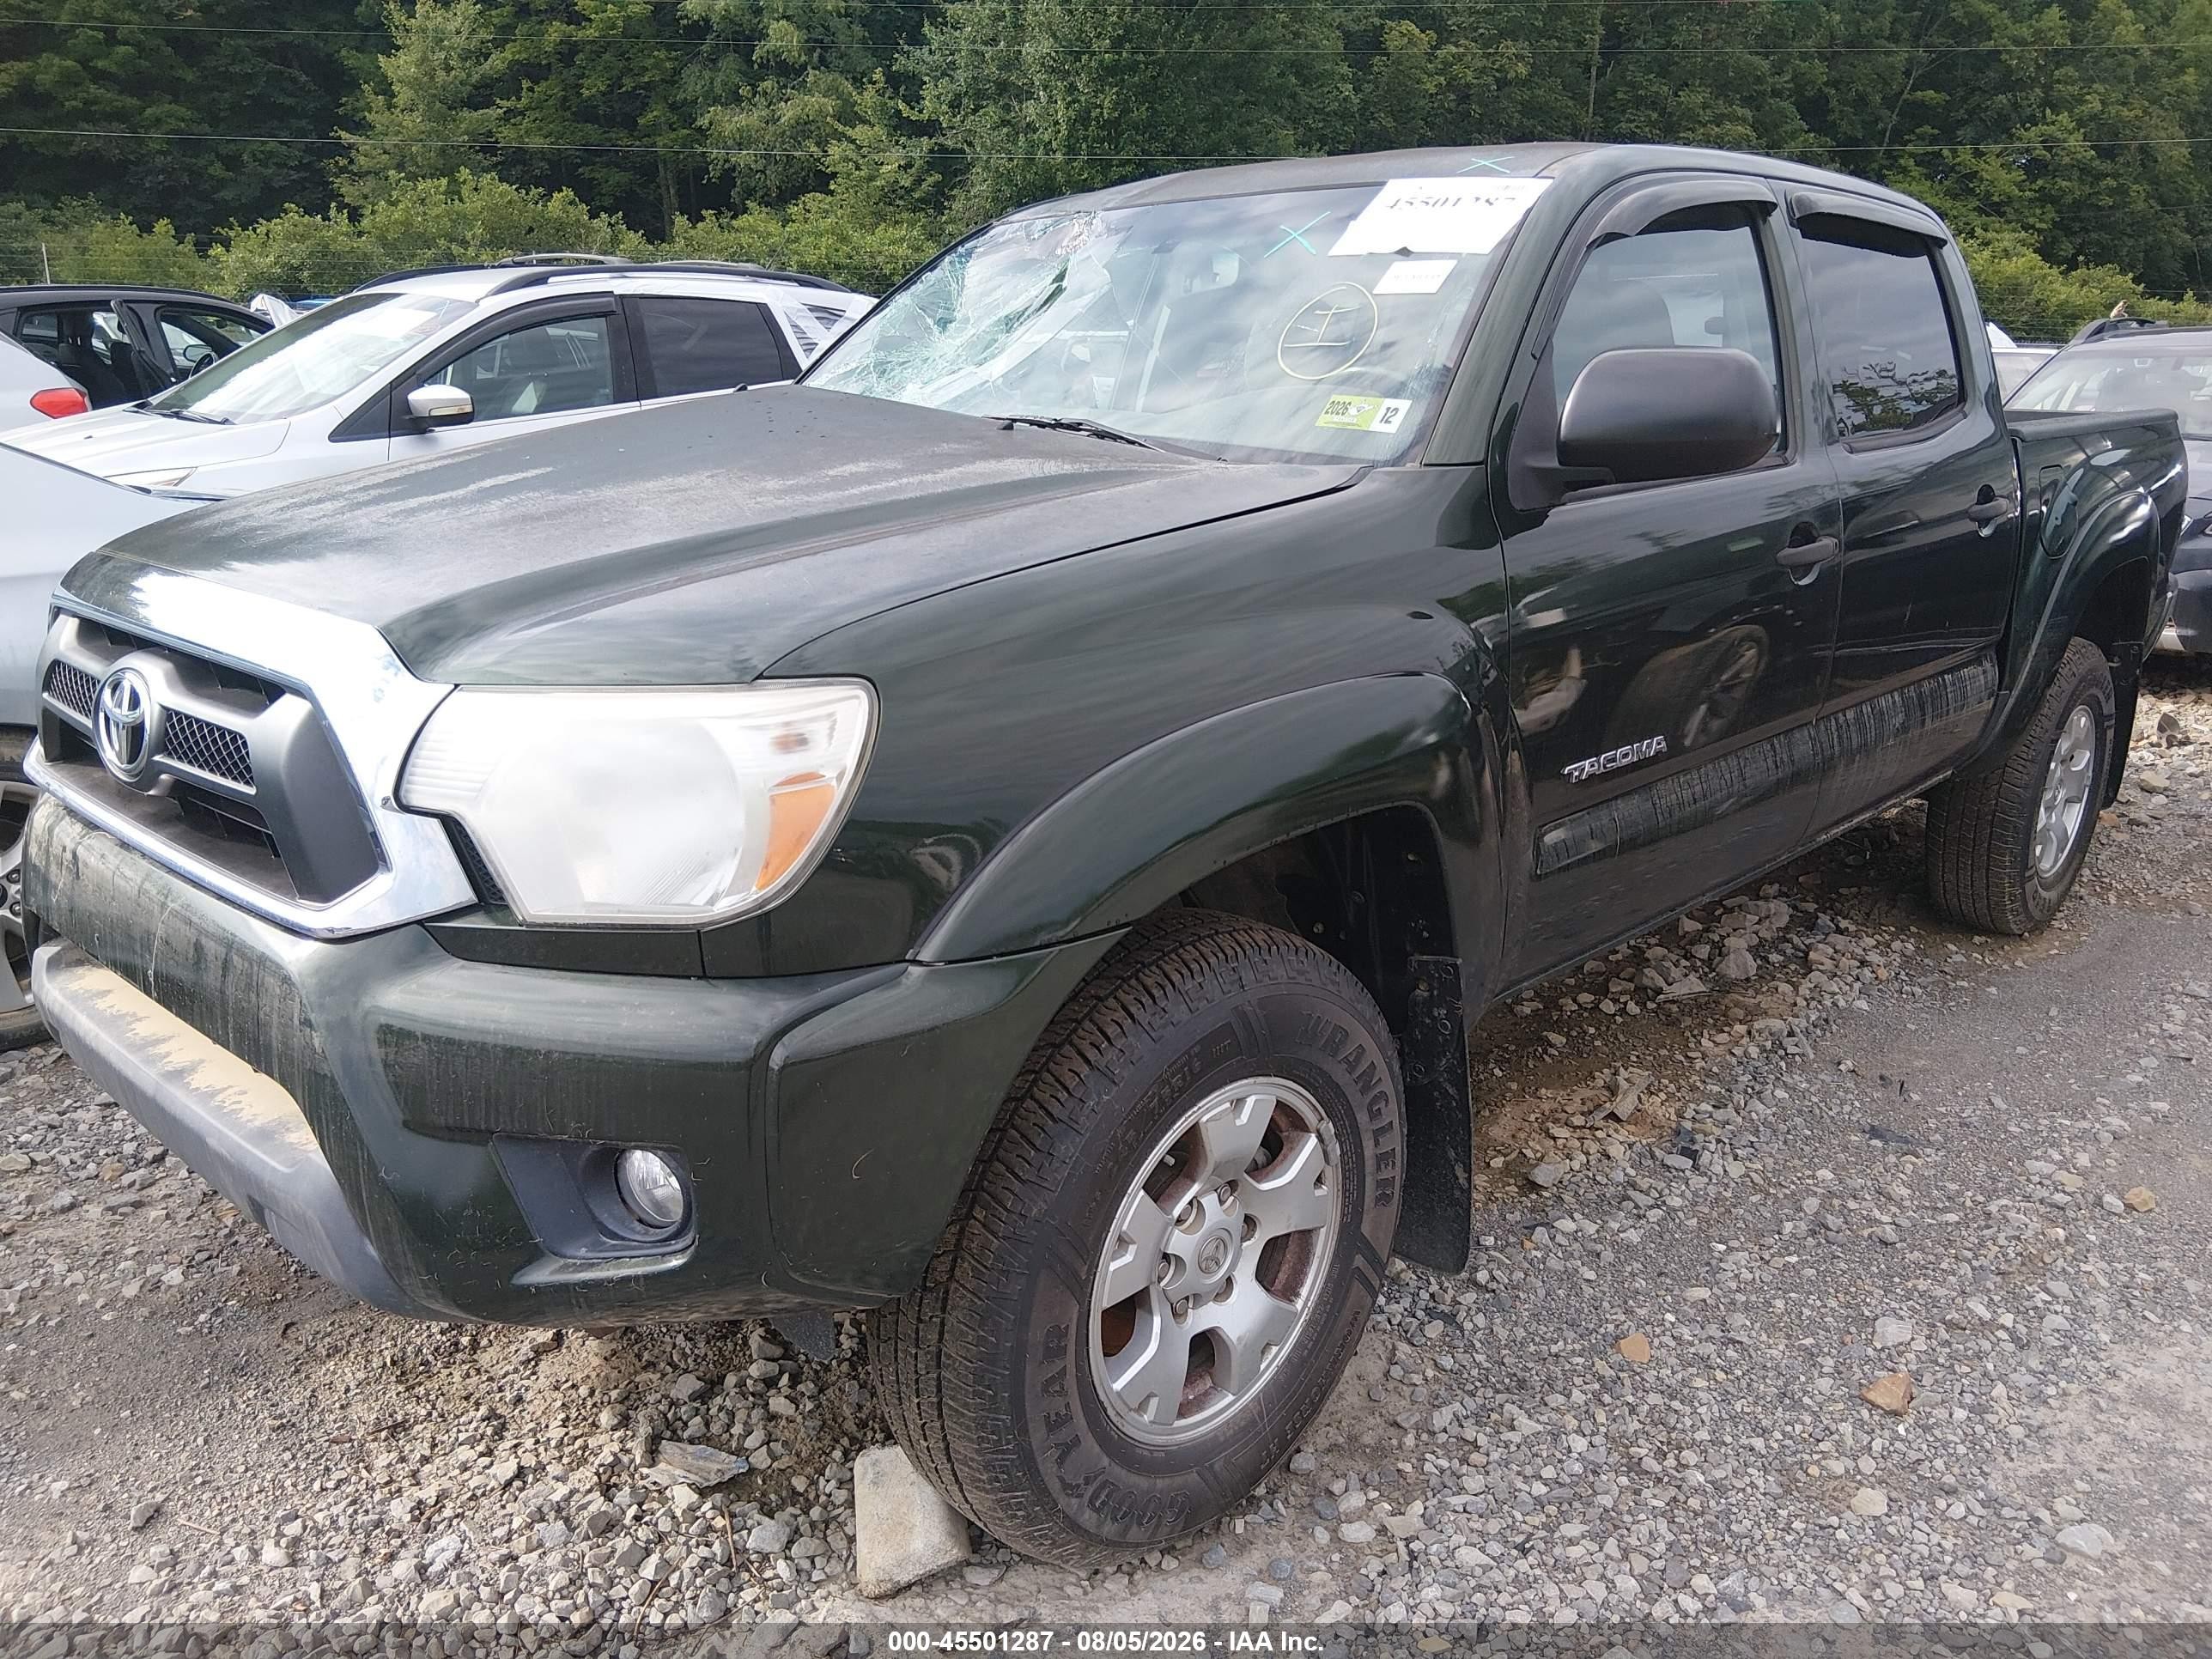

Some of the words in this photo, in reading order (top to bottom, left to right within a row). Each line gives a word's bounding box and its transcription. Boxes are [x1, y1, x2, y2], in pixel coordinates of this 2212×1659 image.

[1323, 400, 1352, 416] 2026
[1378, 406, 1400, 424] 12
[1561, 735, 1668, 783] TACOMA
[1294, 1010, 1396, 1208] WRANGLER
[1041, 1323, 1191, 1530] GOODYEAR
